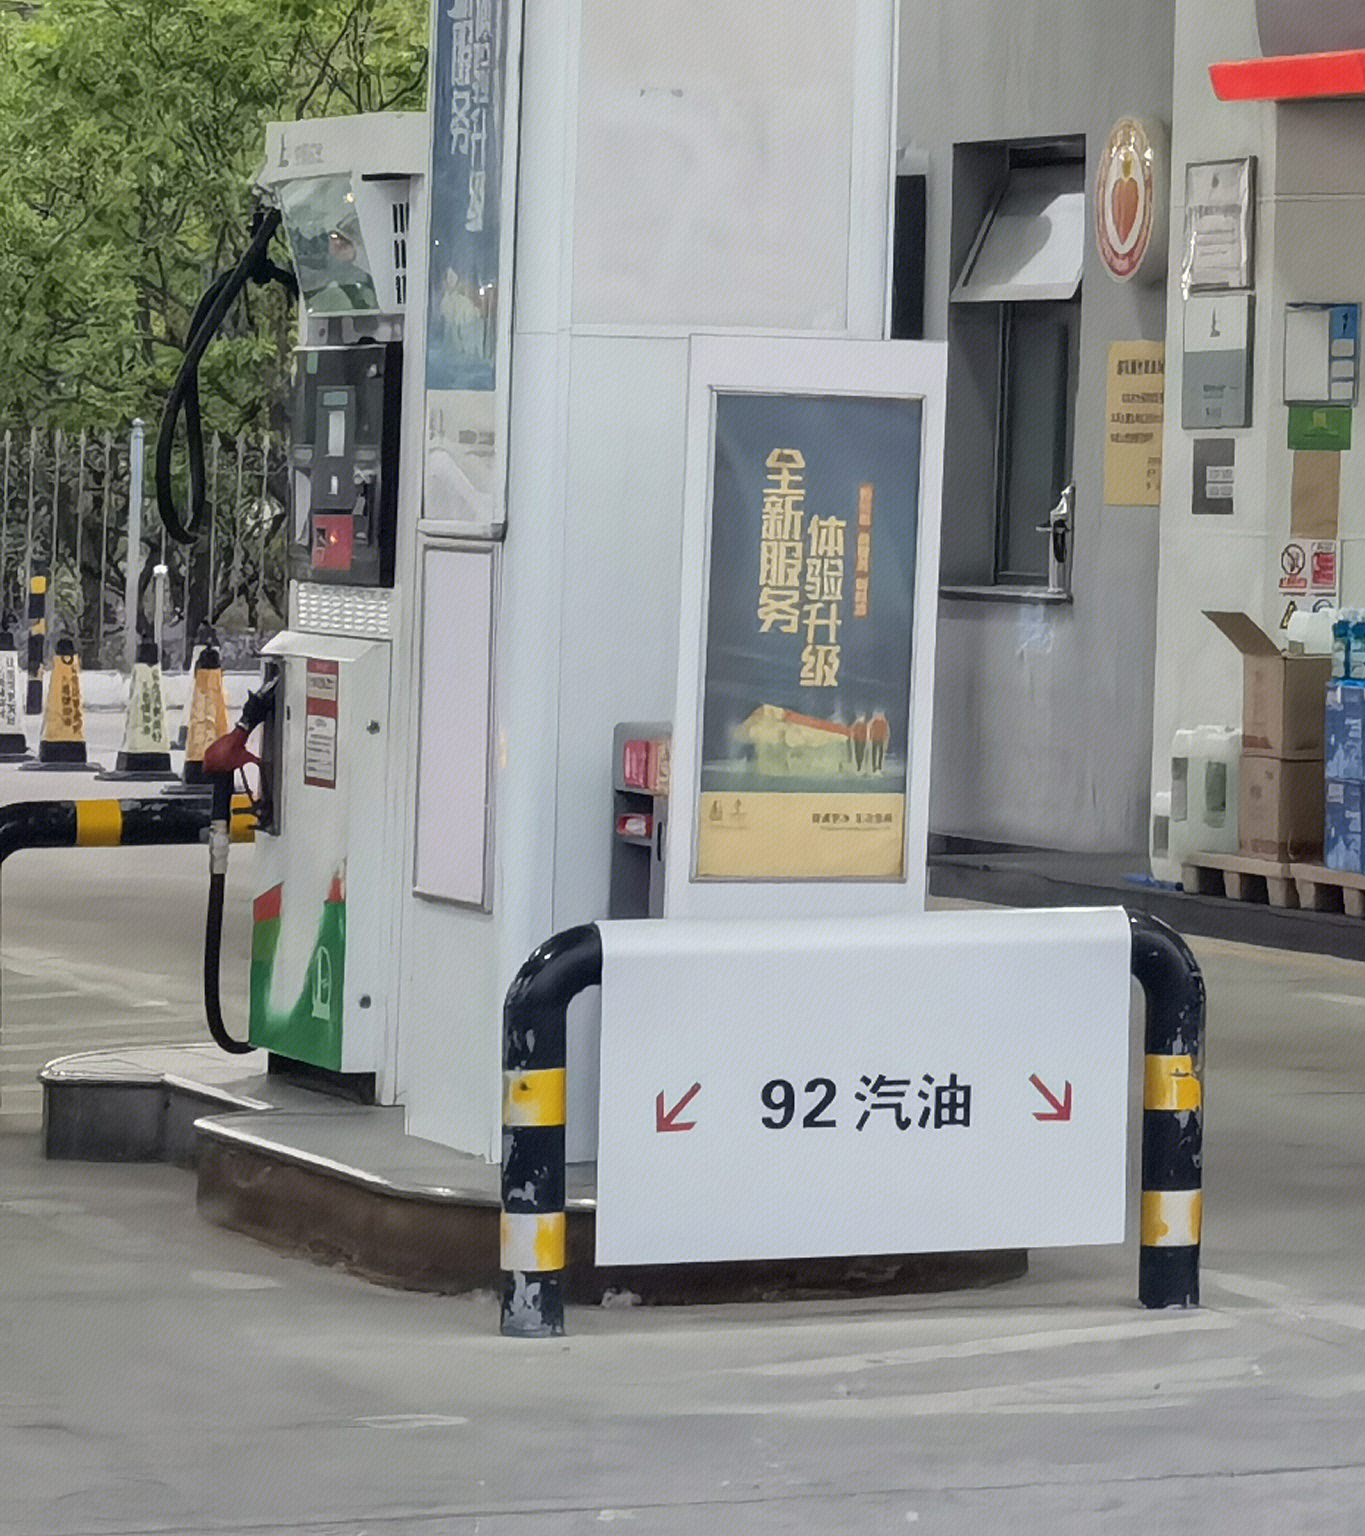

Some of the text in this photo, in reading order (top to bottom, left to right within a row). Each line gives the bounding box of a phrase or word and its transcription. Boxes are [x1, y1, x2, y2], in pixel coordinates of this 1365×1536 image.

[756, 448, 806, 634] 全新服务
[799, 514, 848, 687] 体验升级
